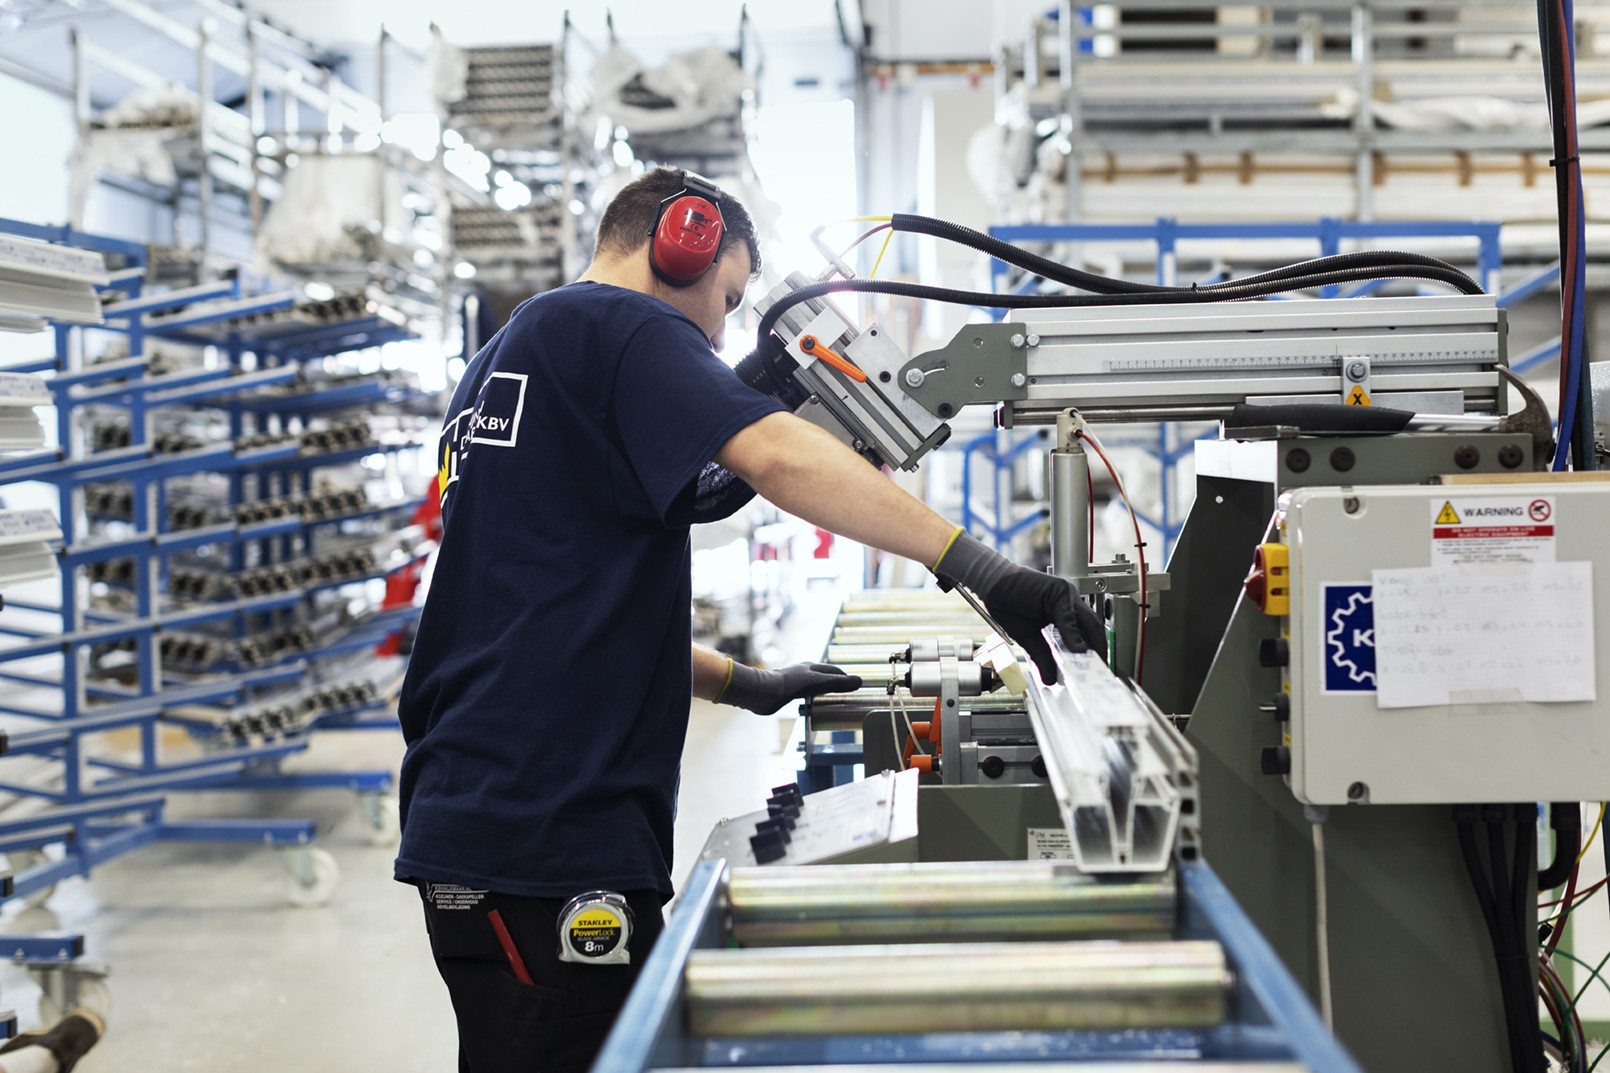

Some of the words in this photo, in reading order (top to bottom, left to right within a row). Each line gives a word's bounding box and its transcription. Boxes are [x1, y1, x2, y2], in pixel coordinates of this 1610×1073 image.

[1353, 393, 1363, 405] X
[1464, 507, 1524, 516] WARNING
[573, 928, 614, 937] PowerLock
[584, 941, 604, 952] 8m
